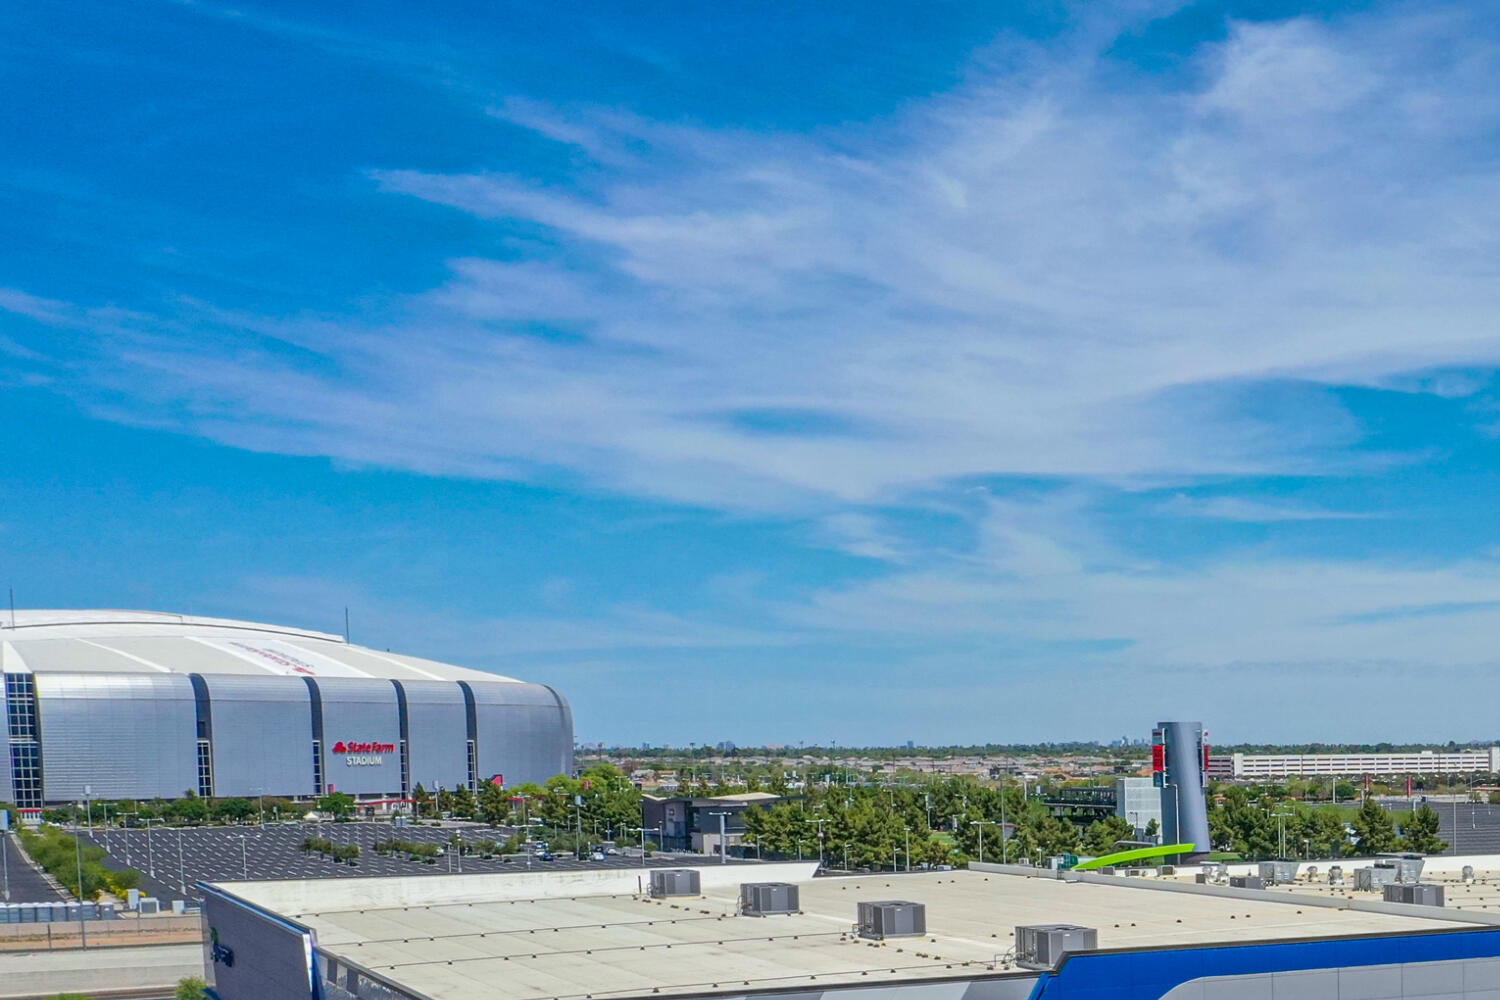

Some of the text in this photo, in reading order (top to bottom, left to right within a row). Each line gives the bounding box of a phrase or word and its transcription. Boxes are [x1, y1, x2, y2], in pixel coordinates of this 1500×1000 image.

[347, 742, 396, 753] State Farm
[346, 756, 382, 766] STADIUM
